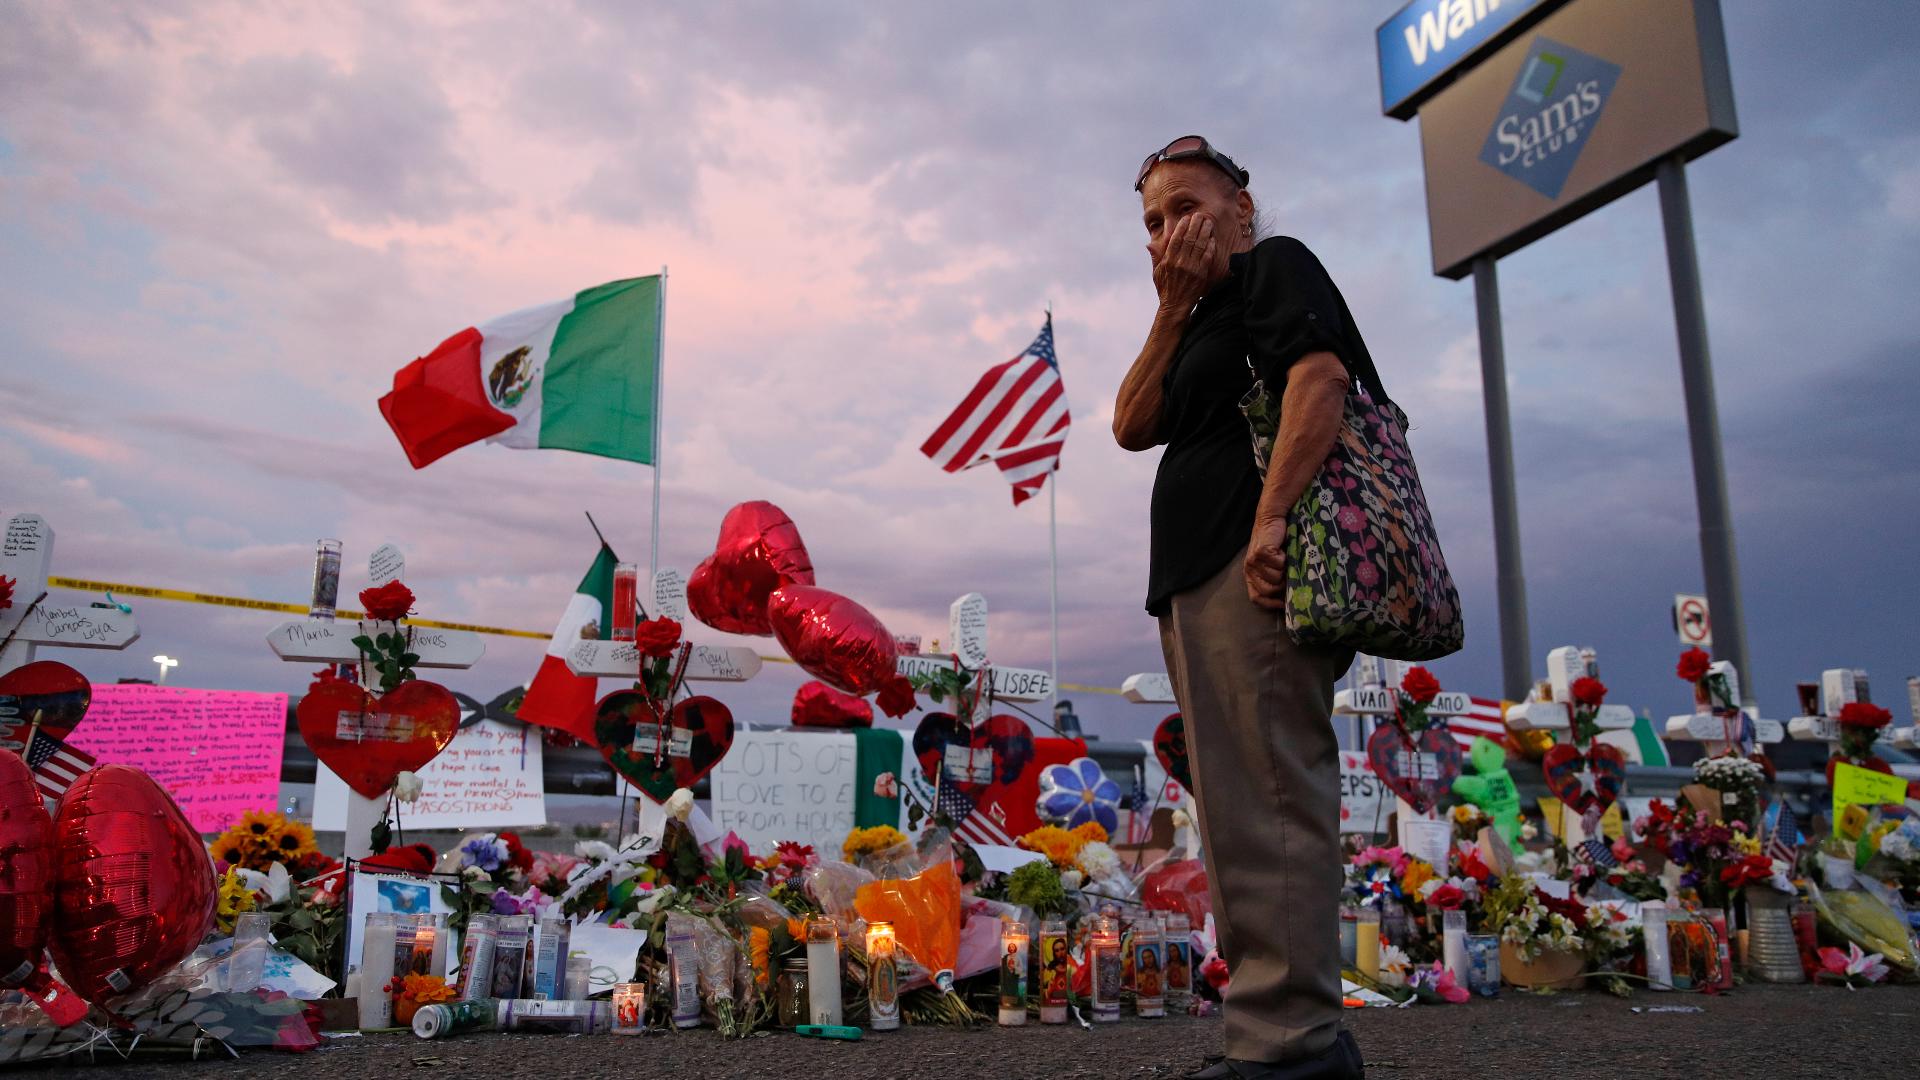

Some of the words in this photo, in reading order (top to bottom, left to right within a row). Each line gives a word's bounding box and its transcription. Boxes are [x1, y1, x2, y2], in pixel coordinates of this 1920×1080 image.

[1403, 0, 1500, 65] Wal
[1497, 80, 1601, 164] Sam's
[1523, 129, 1579, 168] CLUB
[46, 617, 92, 638] Campos
[286, 623, 334, 647] Maria
[696, 645, 732, 667] Raul
[991, 670, 1050, 695] LISBEE
[719, 741, 804, 777] LOTS
[814, 743, 854, 776] OF
[720, 783, 786, 806] LOVE
[799, 783, 826, 805] TO
[719, 810, 786, 833] FROM
[795, 810, 855, 833] HOUS
